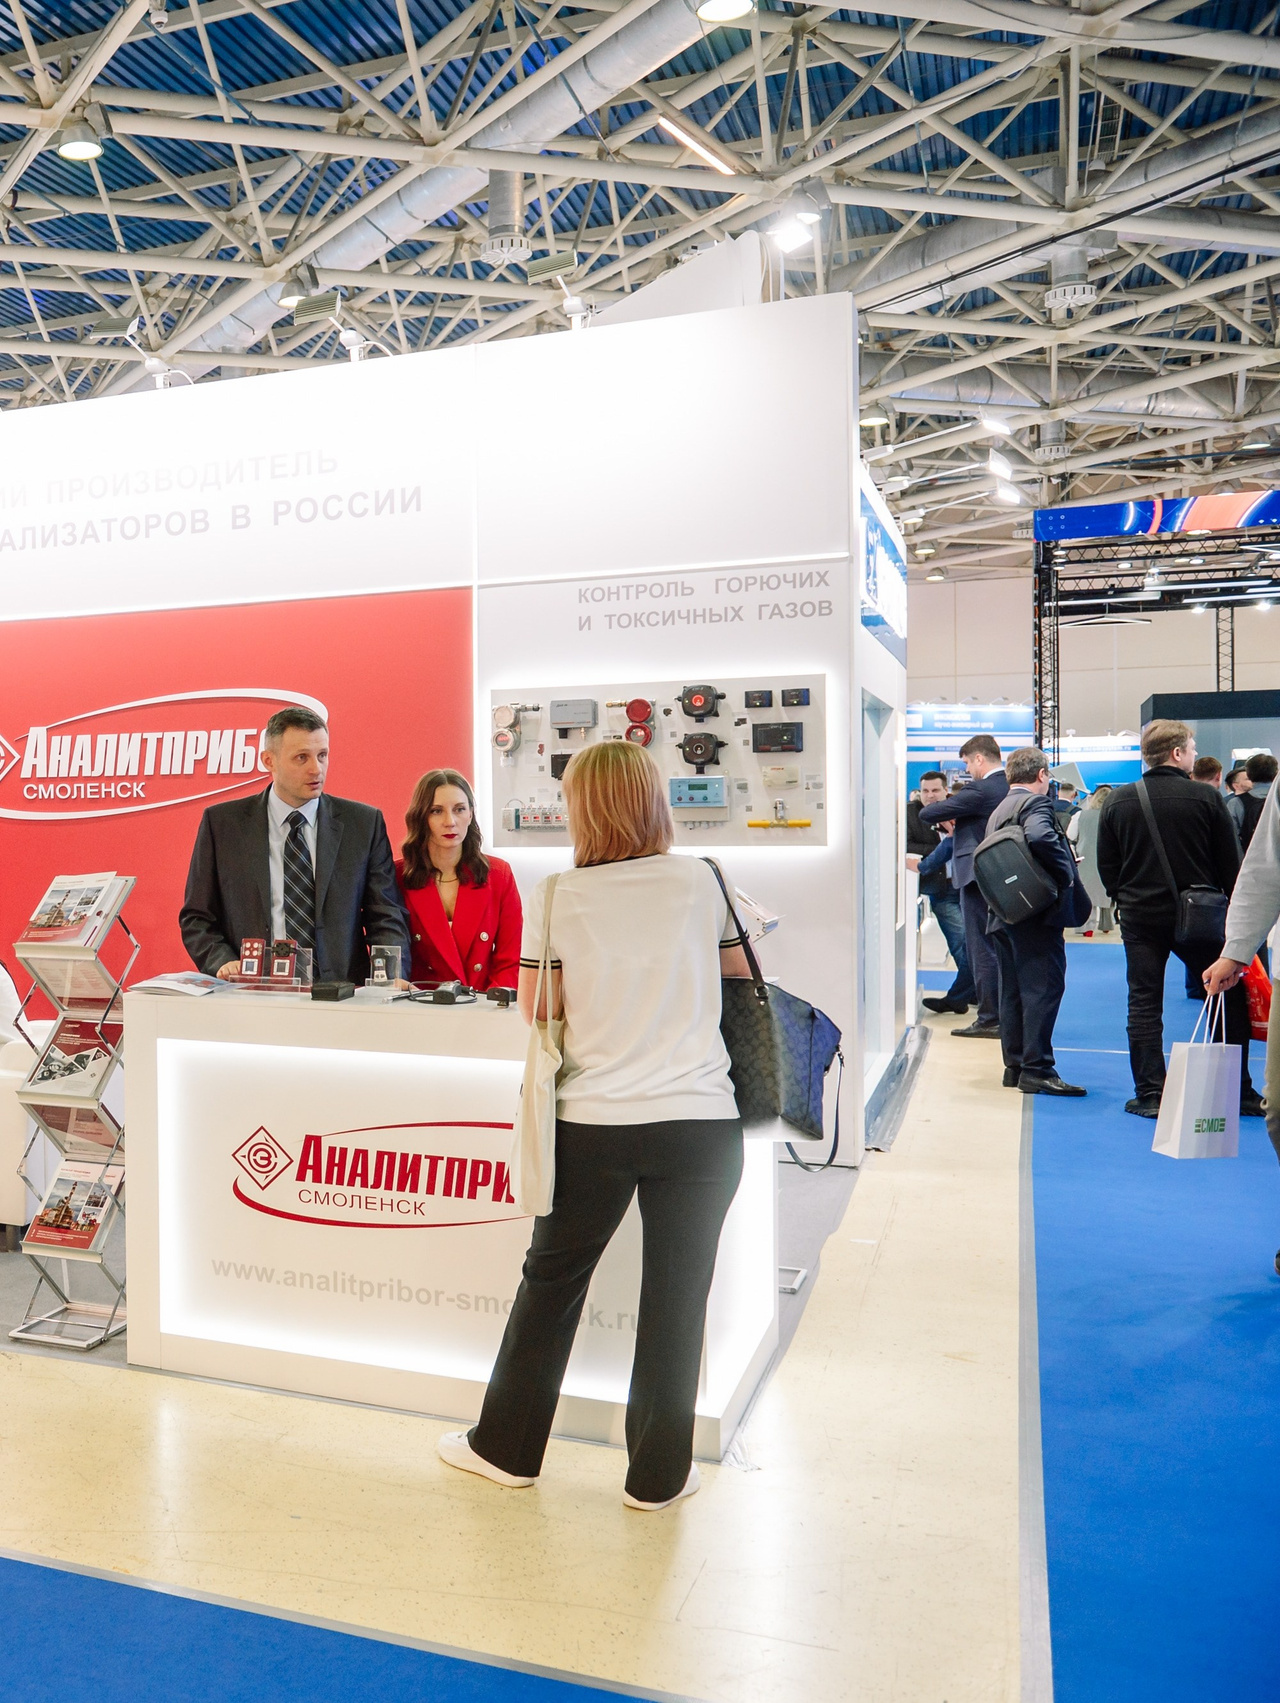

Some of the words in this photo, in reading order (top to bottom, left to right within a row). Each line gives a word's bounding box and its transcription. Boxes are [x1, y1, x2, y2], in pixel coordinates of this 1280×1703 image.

[47, 449, 338, 505] ПРОИЗВОДИТЕЛЬ
[231, 503, 251, 530] В
[273, 486, 423, 526] РОССИИ
[578, 580, 695, 604] КОНТРОЛЬ
[715, 570, 830, 594] ГОРЮЧИХ
[578, 615, 592, 631] И
[604, 605, 744, 630] ТОКСИЧНЫХ
[758, 600, 834, 620] ГАЗОВ
[23, 782, 145, 800] СМОЛЕНСК
[298, 1188, 425, 1216] СМОЛЕНСК
[211, 1259, 638, 1333] www.analitpribor-smok.r
